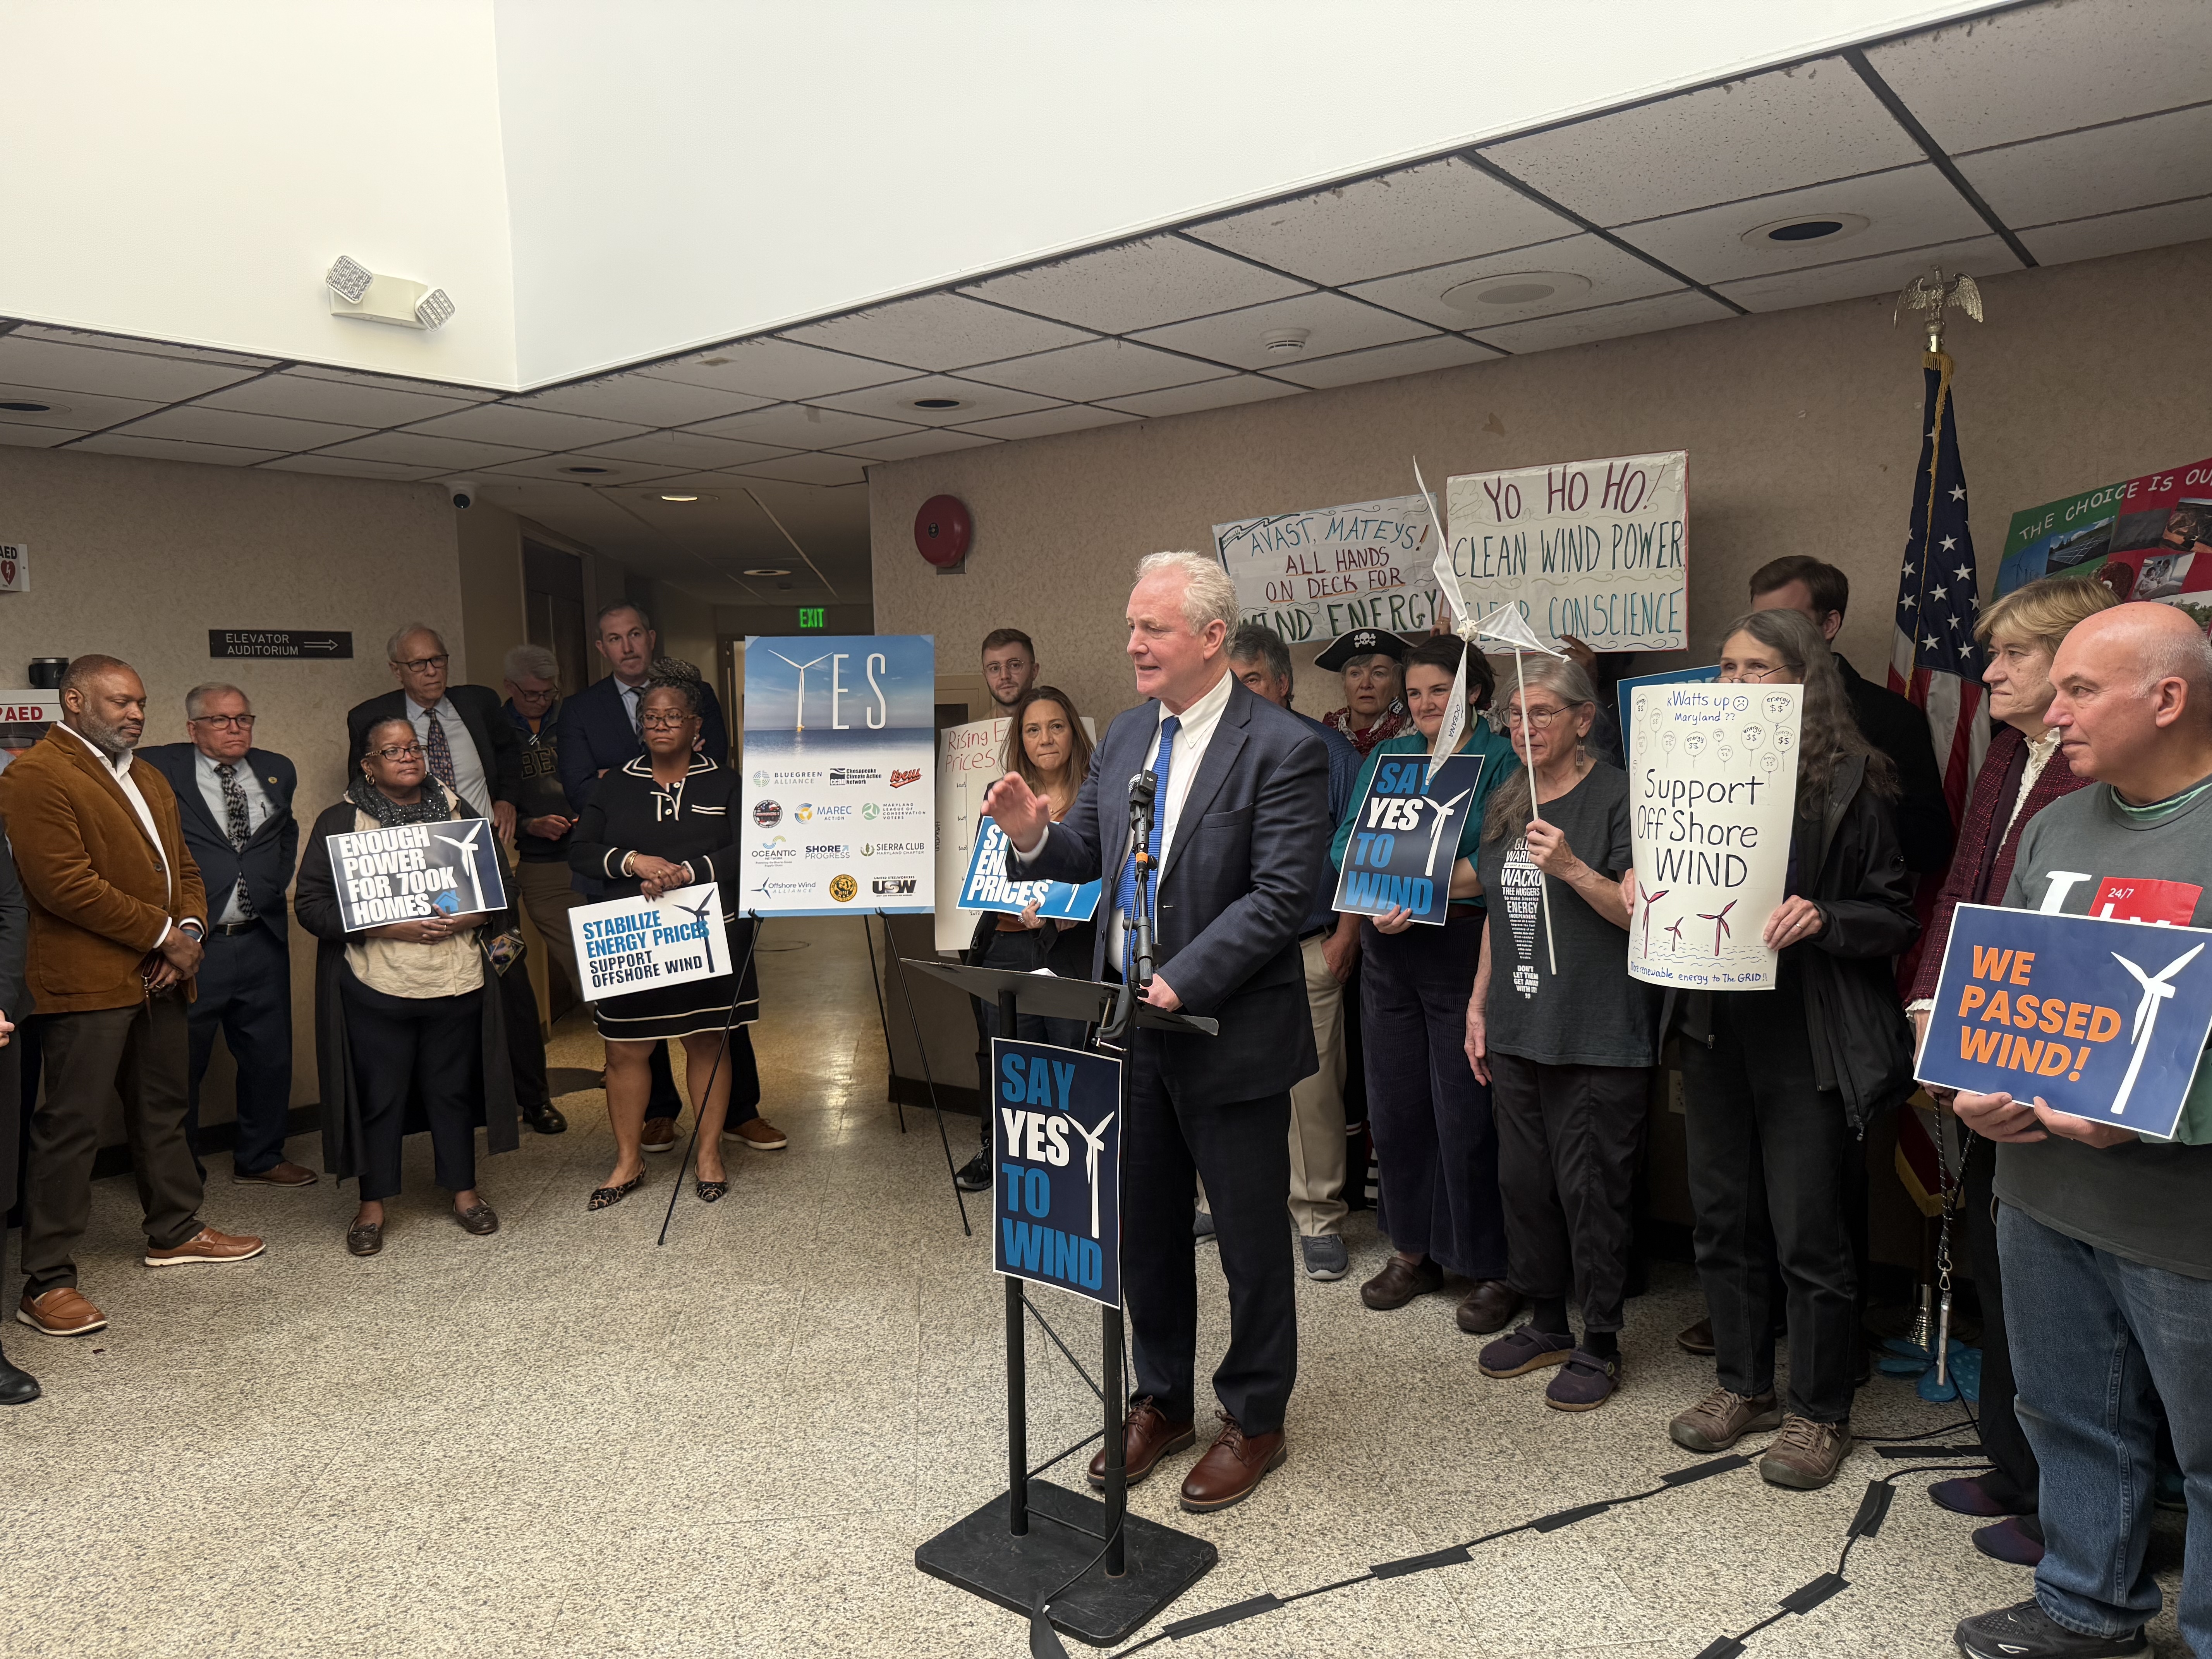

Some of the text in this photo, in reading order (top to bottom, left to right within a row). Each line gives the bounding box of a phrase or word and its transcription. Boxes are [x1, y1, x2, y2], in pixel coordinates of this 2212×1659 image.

[1483, 462, 1665, 522] YO HO HO!
[2019, 469, 2212, 540] THE CHOICE IS OU
[1251, 516, 1429, 557] AVAST, MATEYS!
[1453, 531, 1526, 578] CLEAN
[1541, 524, 1600, 573] WIND
[1286, 546, 1389, 575] ALL HANDS
[1266, 567, 1406, 601] ON DECK FOR
[800, 608, 824, 628] EXIT
[1327, 589, 1437, 637] ENERGY
[1549, 588, 1683, 640] CONSCIENCE
[226, 634, 289, 644] ELEVATOR
[227, 646, 299, 655] AUDITORIUM
[5, 706, 43, 721] AED
[1714, 697, 1729, 711] up
[1767, 697, 1790, 706] energy
[1448, 704, 1460, 737] OCEANA
[1675, 711, 1720, 725] Maryland
[1743, 726, 1762, 735] energy
[948, 730, 988, 752] Rising
[946, 749, 995, 773] Prices
[1376, 763, 1437, 795] SAY
[1645, 768, 1764, 808] Support
[817, 806, 852, 815] MAREC
[1367, 797, 1424, 831] YES
[338, 826, 431, 858] ENOUGH
[1355, 832, 1395, 868] TO
[343, 848, 427, 880] POWER
[1501, 869, 1542, 887] WACKO
[1656, 847, 1747, 888] WIND
[347, 866, 458, 903] FOR 700K
[872, 879, 917, 894] USW
[967, 875, 1049, 908] PRICES
[1345, 871, 1433, 915] WIND
[1502, 887, 1540, 896] TREE HUGGERS
[2107, 887, 2135, 900] 24/7
[351, 893, 432, 926] HOMES
[1507, 901, 1538, 914] ENERGY
[583, 910, 662, 940] STABILIZE
[586, 931, 646, 958] ENERGY
[589, 950, 653, 974] SUPPORT
[592, 955, 703, 988] OFFSHORE WIND
[1640, 967, 1673, 979] renewable
[1678, 974, 1708, 985] energy
[1723, 974, 1735, 983] The
[1973, 945, 2035, 986] WE
[1958, 984, 2121, 1042] PASSED
[1961, 1025, 2091, 1082] WIND!
[1001, 1053, 1075, 1111] SAY
[1001, 1107, 1070, 1166] YES
[1002, 1163, 1050, 1218] TO
[1002, 1217, 1102, 1291] WIND
